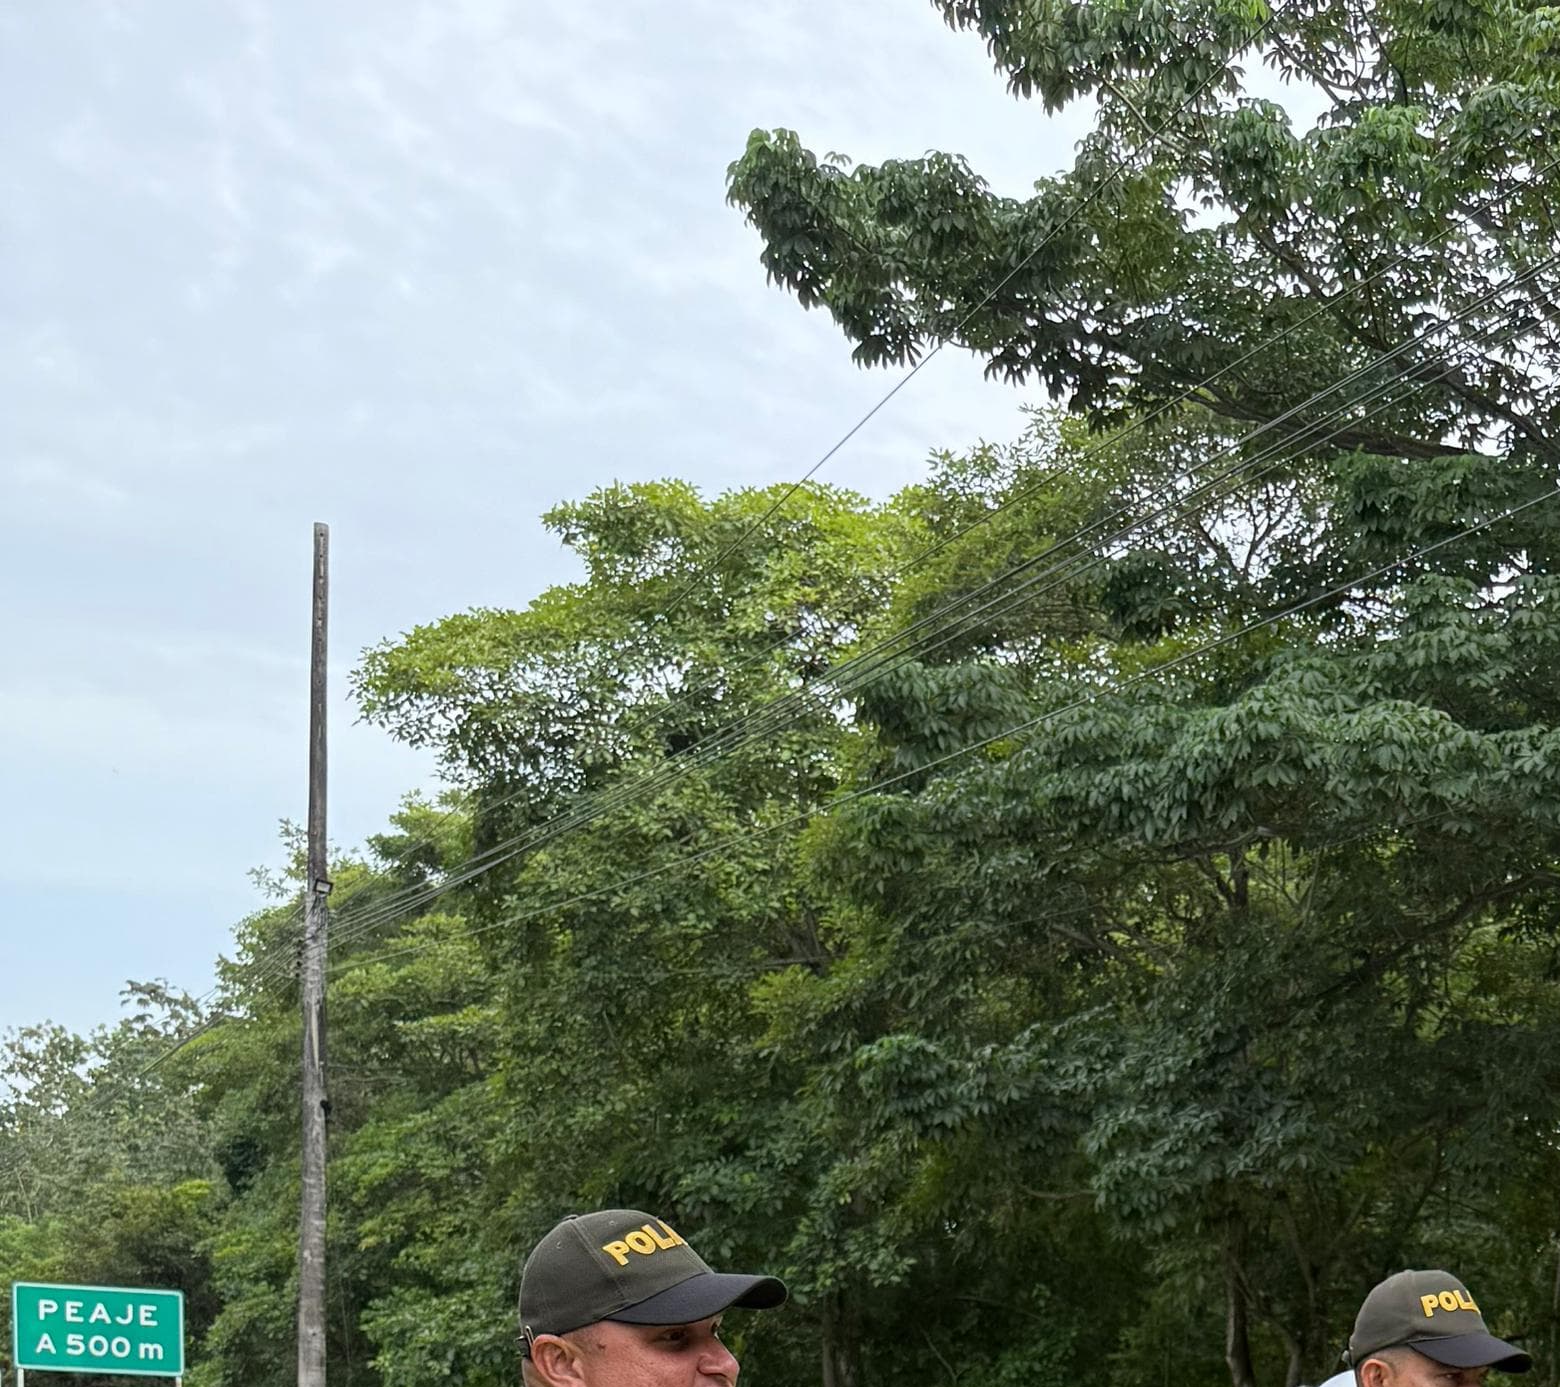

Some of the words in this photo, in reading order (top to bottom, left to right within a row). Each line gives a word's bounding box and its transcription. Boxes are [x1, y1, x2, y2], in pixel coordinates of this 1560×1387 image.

[602, 1220, 687, 1266] POLI
[38, 1299, 158, 1326] PEAJE
[35, 1332, 57, 1354] A
[66, 1333, 131, 1358] 500
[138, 1342, 164, 1360] m
